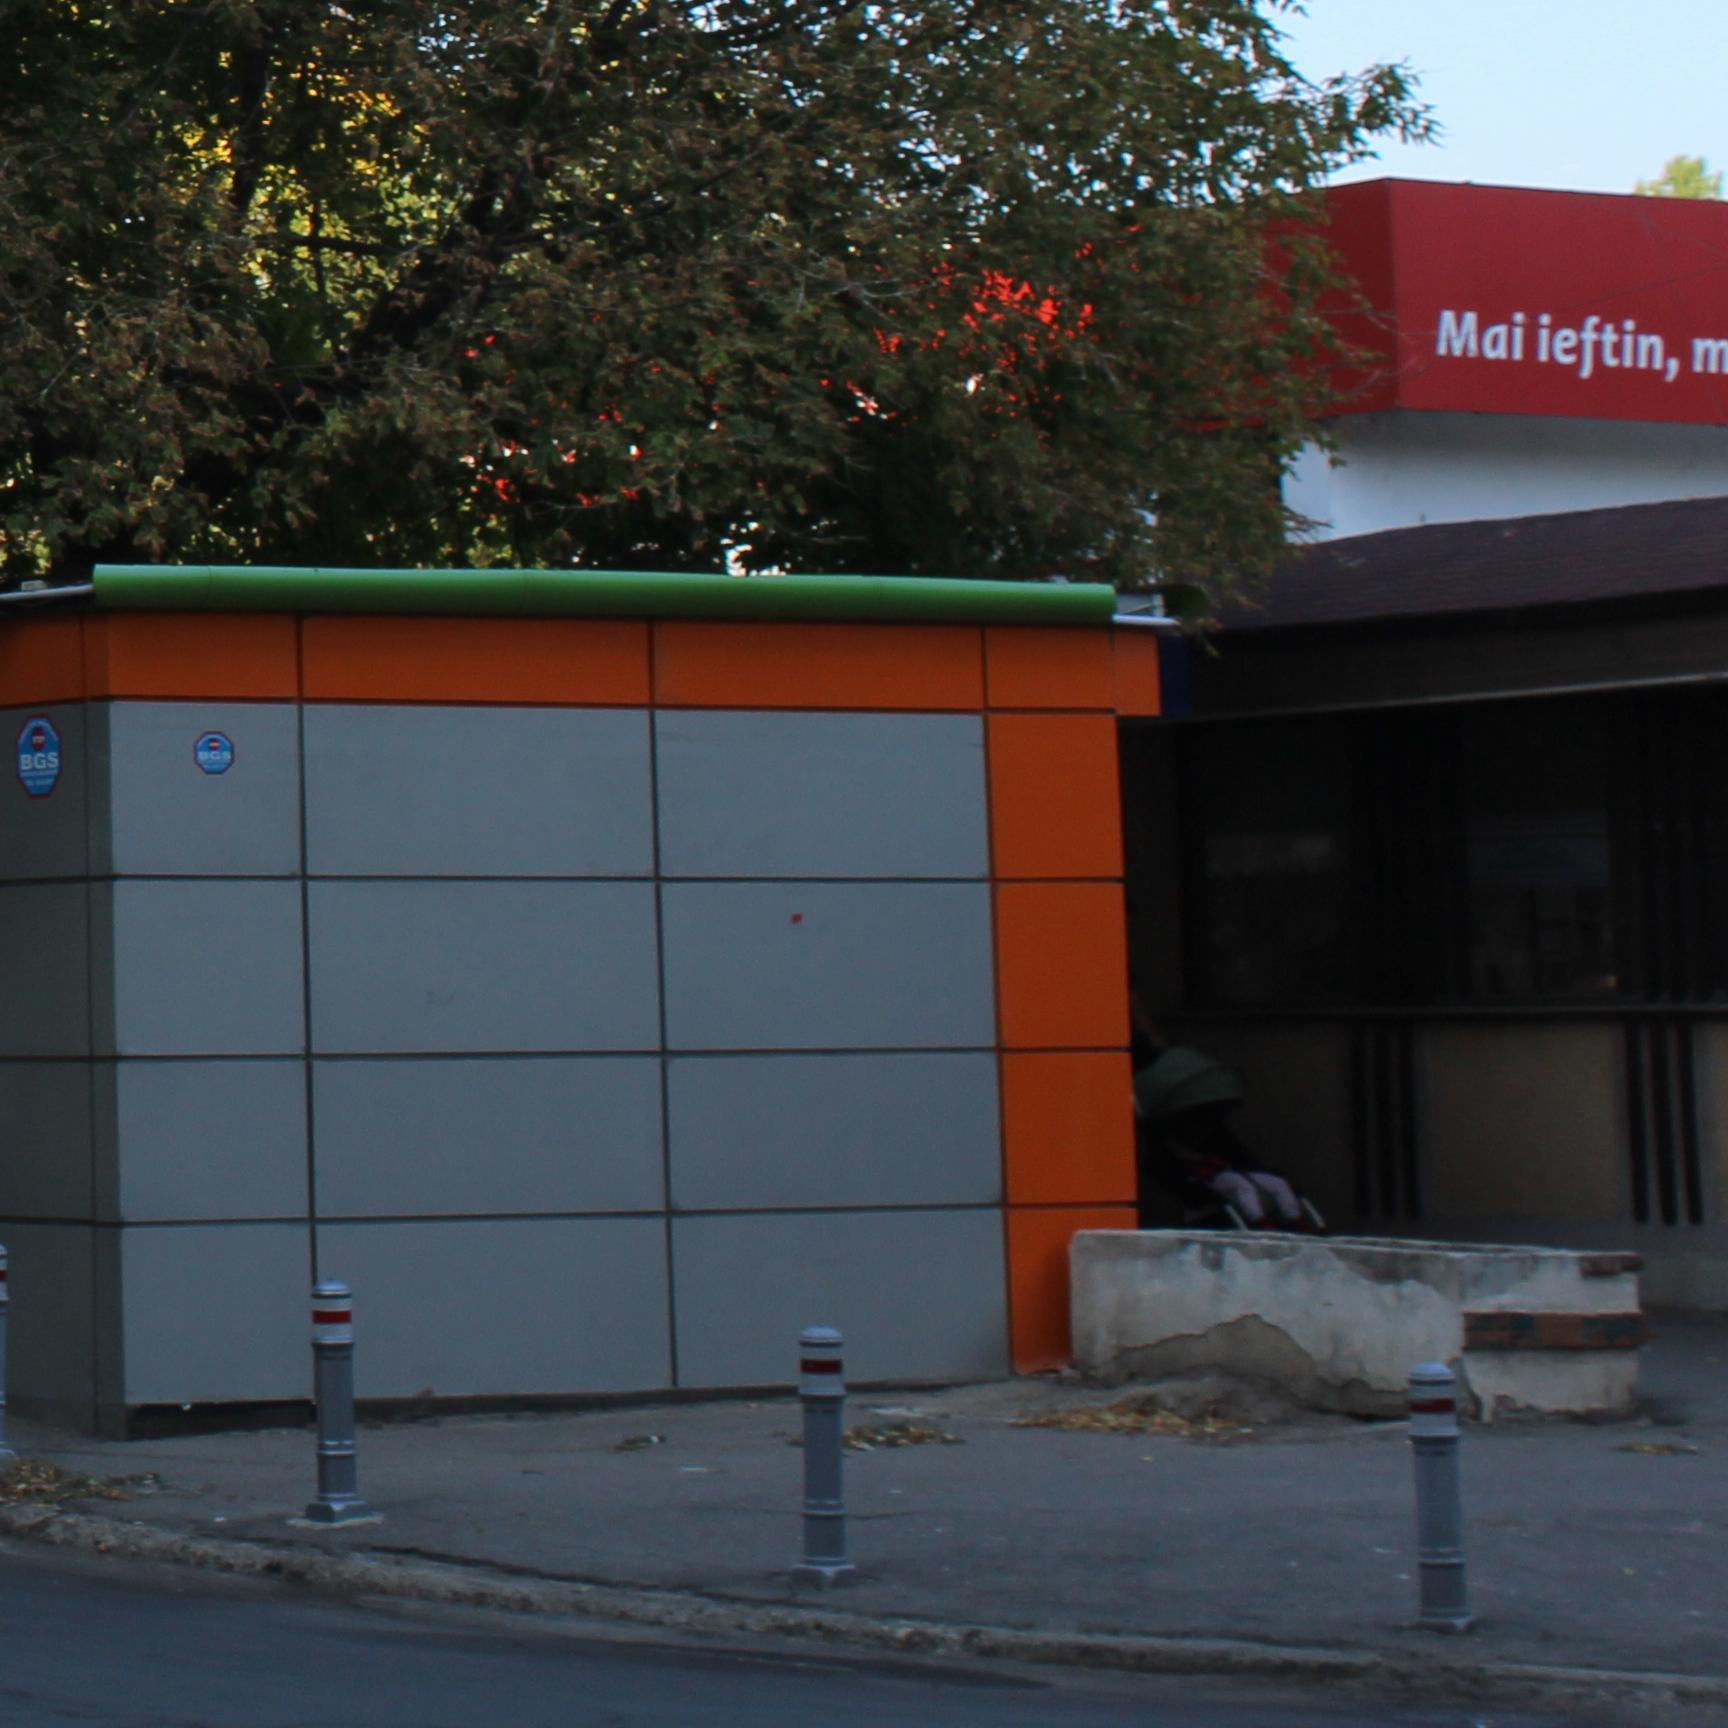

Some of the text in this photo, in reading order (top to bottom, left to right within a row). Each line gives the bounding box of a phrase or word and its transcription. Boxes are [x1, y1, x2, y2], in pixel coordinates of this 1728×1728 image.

[1437, 310, 1526, 361] Mai
[1537, 313, 1680, 383] ieftin,
[20, 752, 59, 770] BGS
